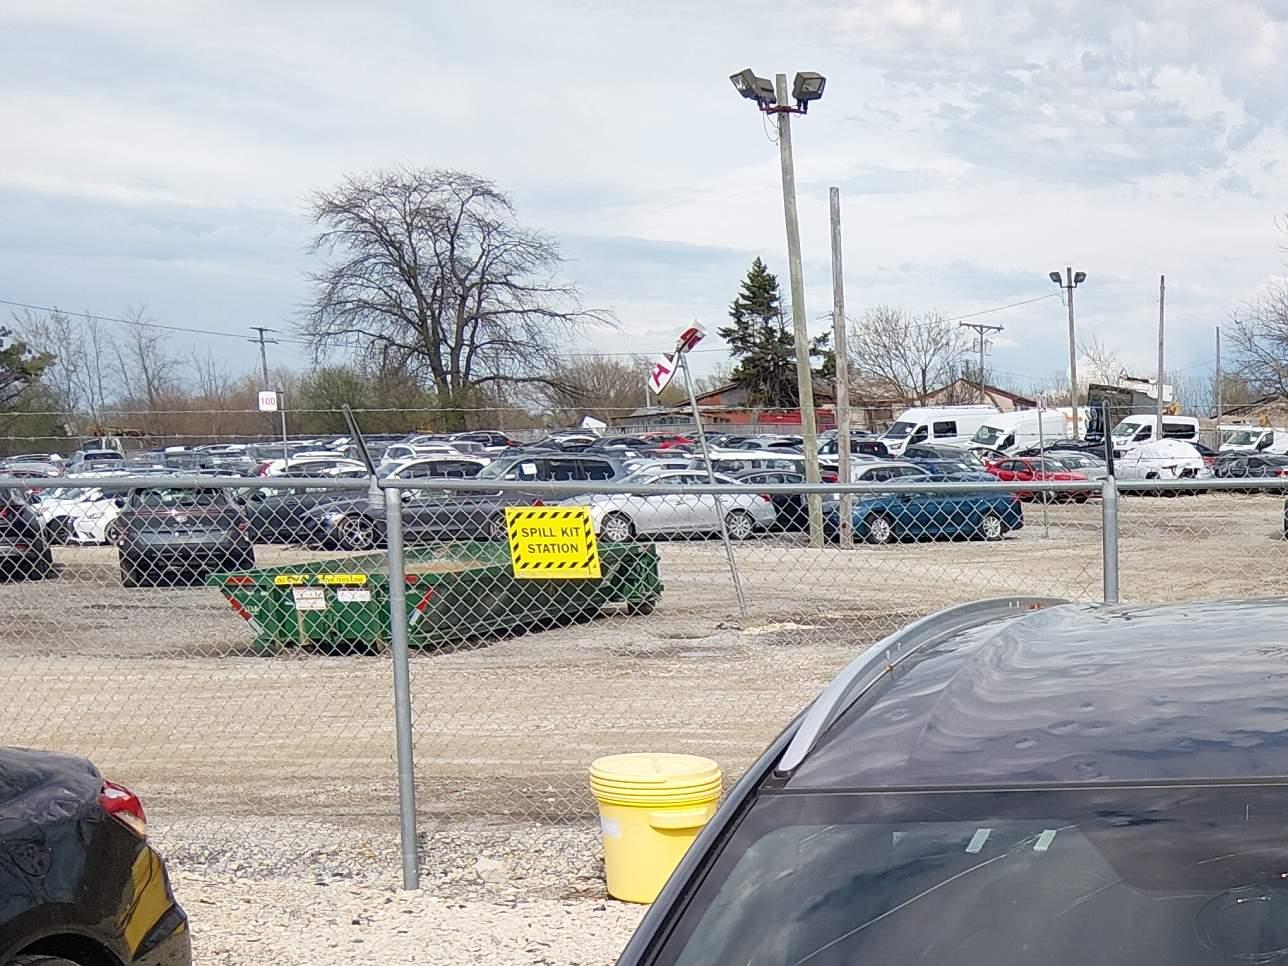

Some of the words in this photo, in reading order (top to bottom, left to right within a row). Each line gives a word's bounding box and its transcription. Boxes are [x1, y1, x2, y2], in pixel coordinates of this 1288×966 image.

[261, 397, 276, 406] 100
[521, 527, 557, 538] SPILL
[561, 526, 581, 538] KIT
[527, 543, 579, 554] STATION
